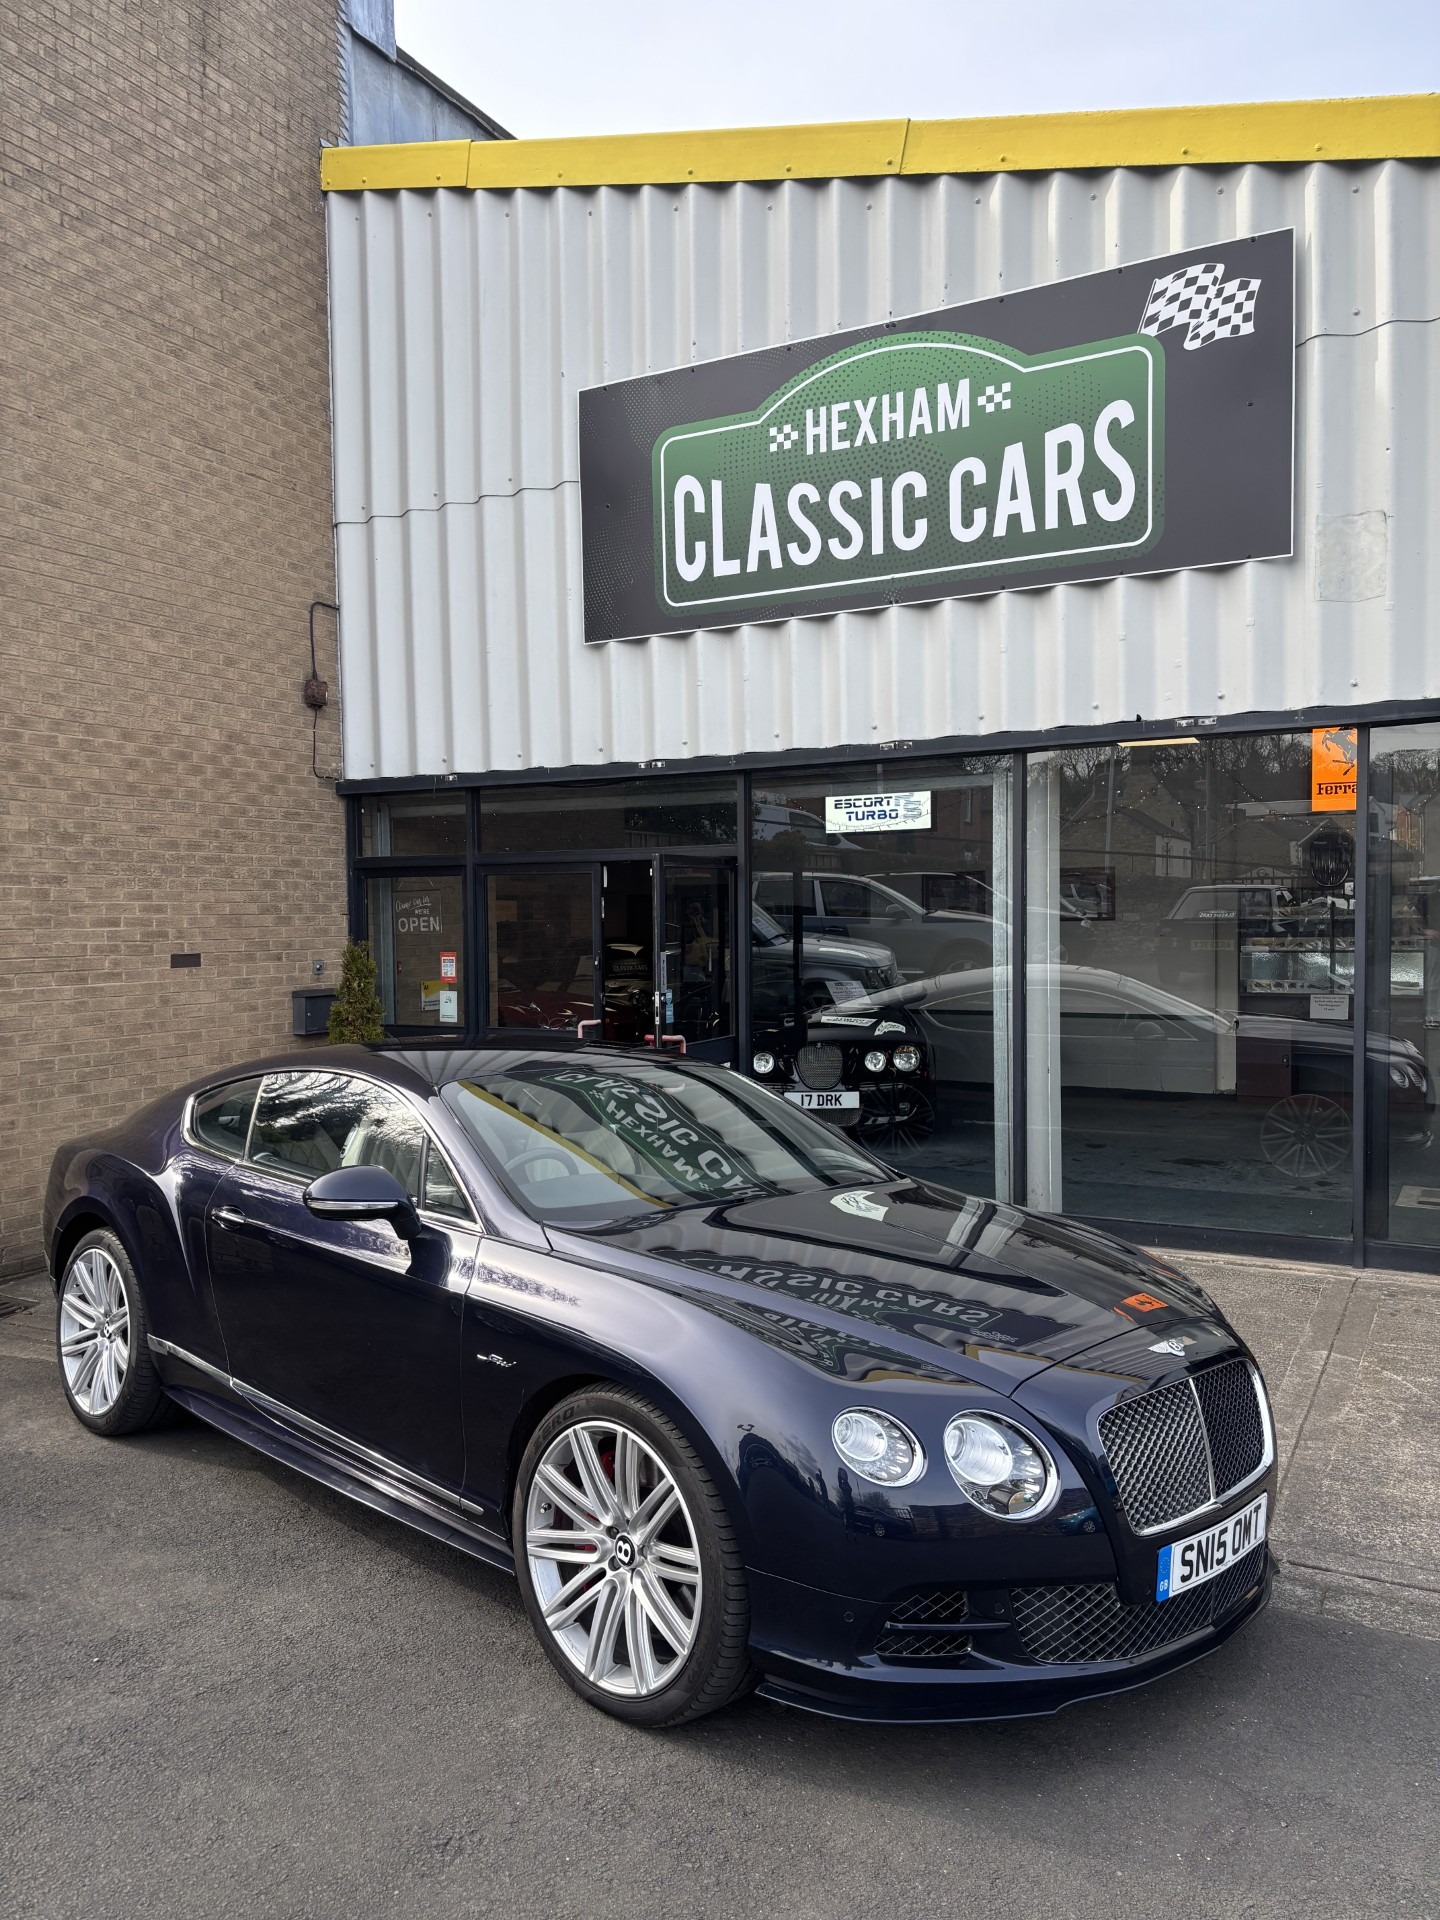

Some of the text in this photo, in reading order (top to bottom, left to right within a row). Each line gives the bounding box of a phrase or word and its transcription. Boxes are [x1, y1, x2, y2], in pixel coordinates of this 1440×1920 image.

[805, 378, 970, 456] HEXHAM
[673, 399, 1136, 582] CLASSIC CARS
[834, 796, 893, 809] ESCORT
[846, 809, 899, 821] TURBO
[398, 916, 440, 932] OPEN
[817, 1094, 842, 1106] DRK
[1180, 1502, 1262, 1583] SN15 OMT
[1159, 1579, 1168, 1592] GB
